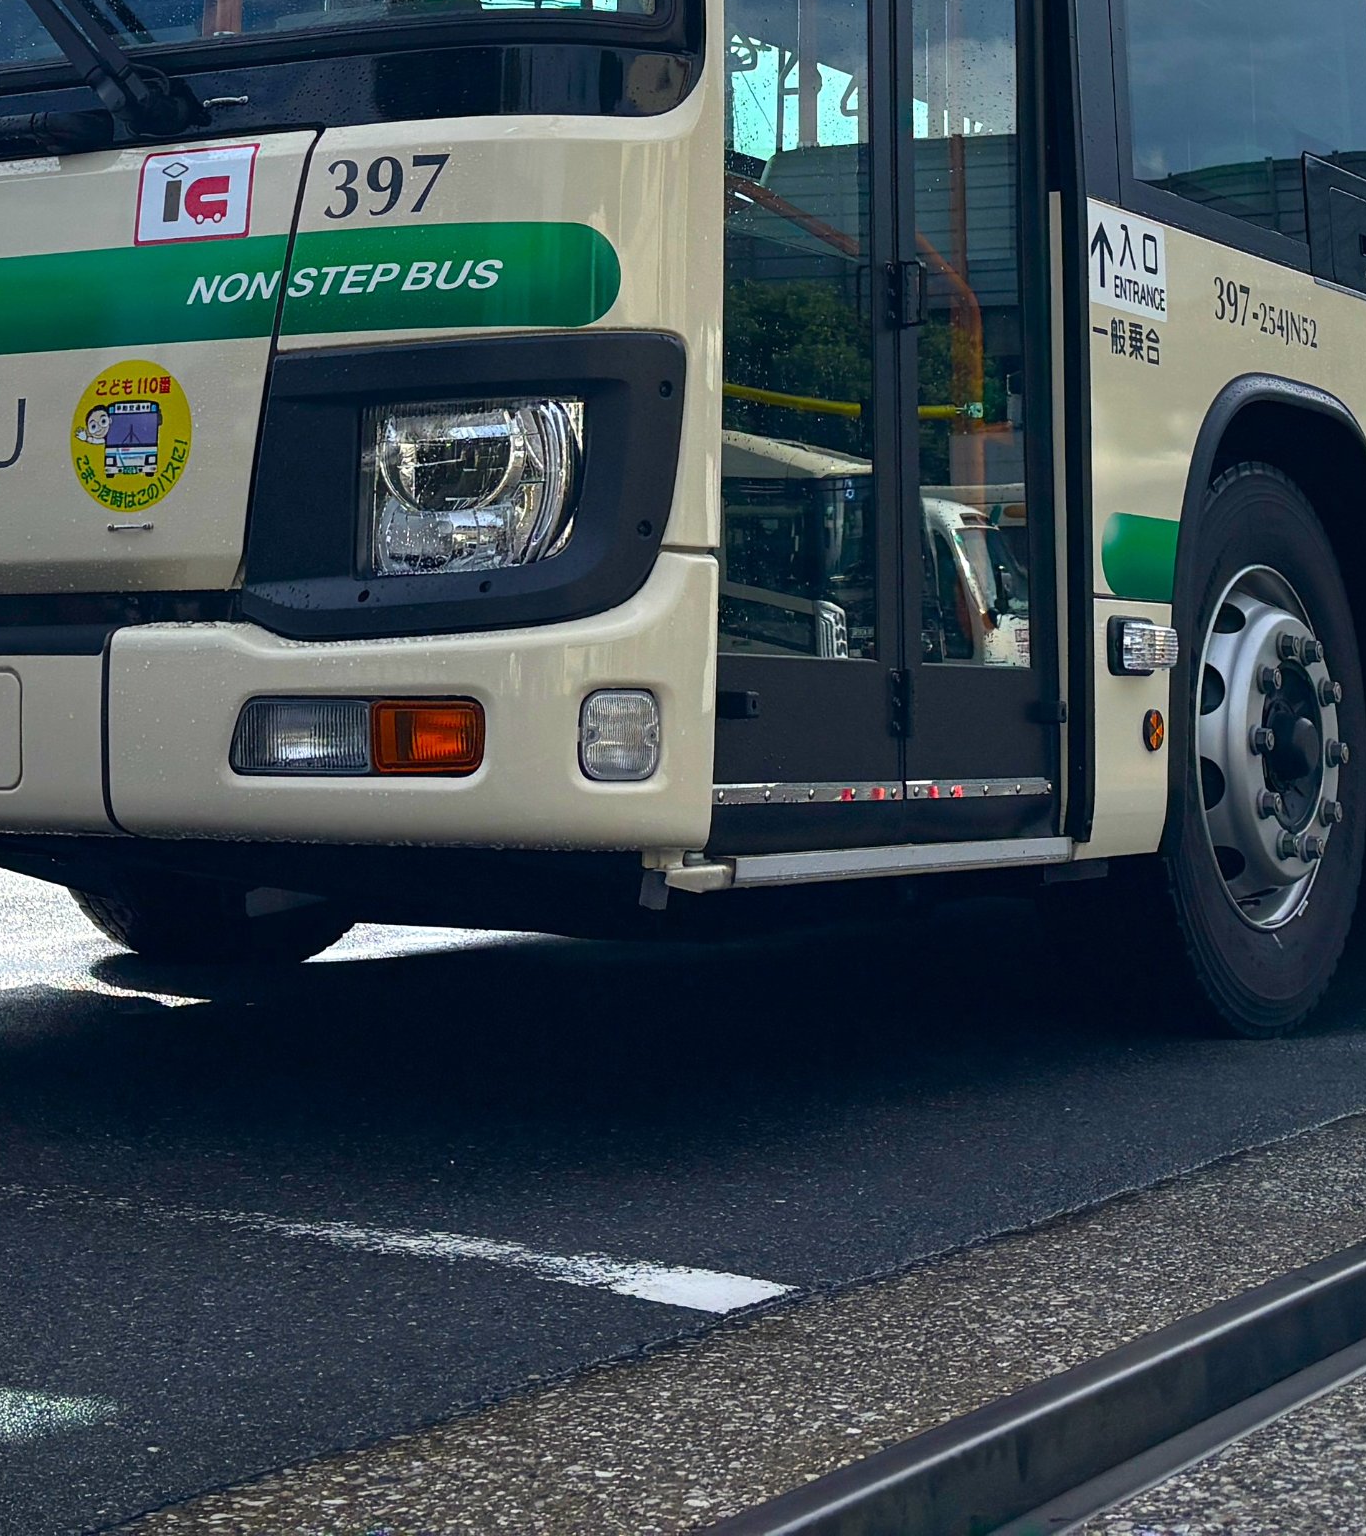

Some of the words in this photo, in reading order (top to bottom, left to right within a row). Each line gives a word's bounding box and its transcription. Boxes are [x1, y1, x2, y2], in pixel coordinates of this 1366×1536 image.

[324, 153, 451, 220] 397
[1119, 223, 1159, 275] 入口
[187, 271, 282, 305] NON
[287, 262, 401, 298] STEP
[401, 259, 504, 291] BUS
[1114, 275, 1166, 312] ENTRANCE
[1214, 276, 1318, 349] 397-254JN52
[1092, 317, 1160, 366] 一般乗合
